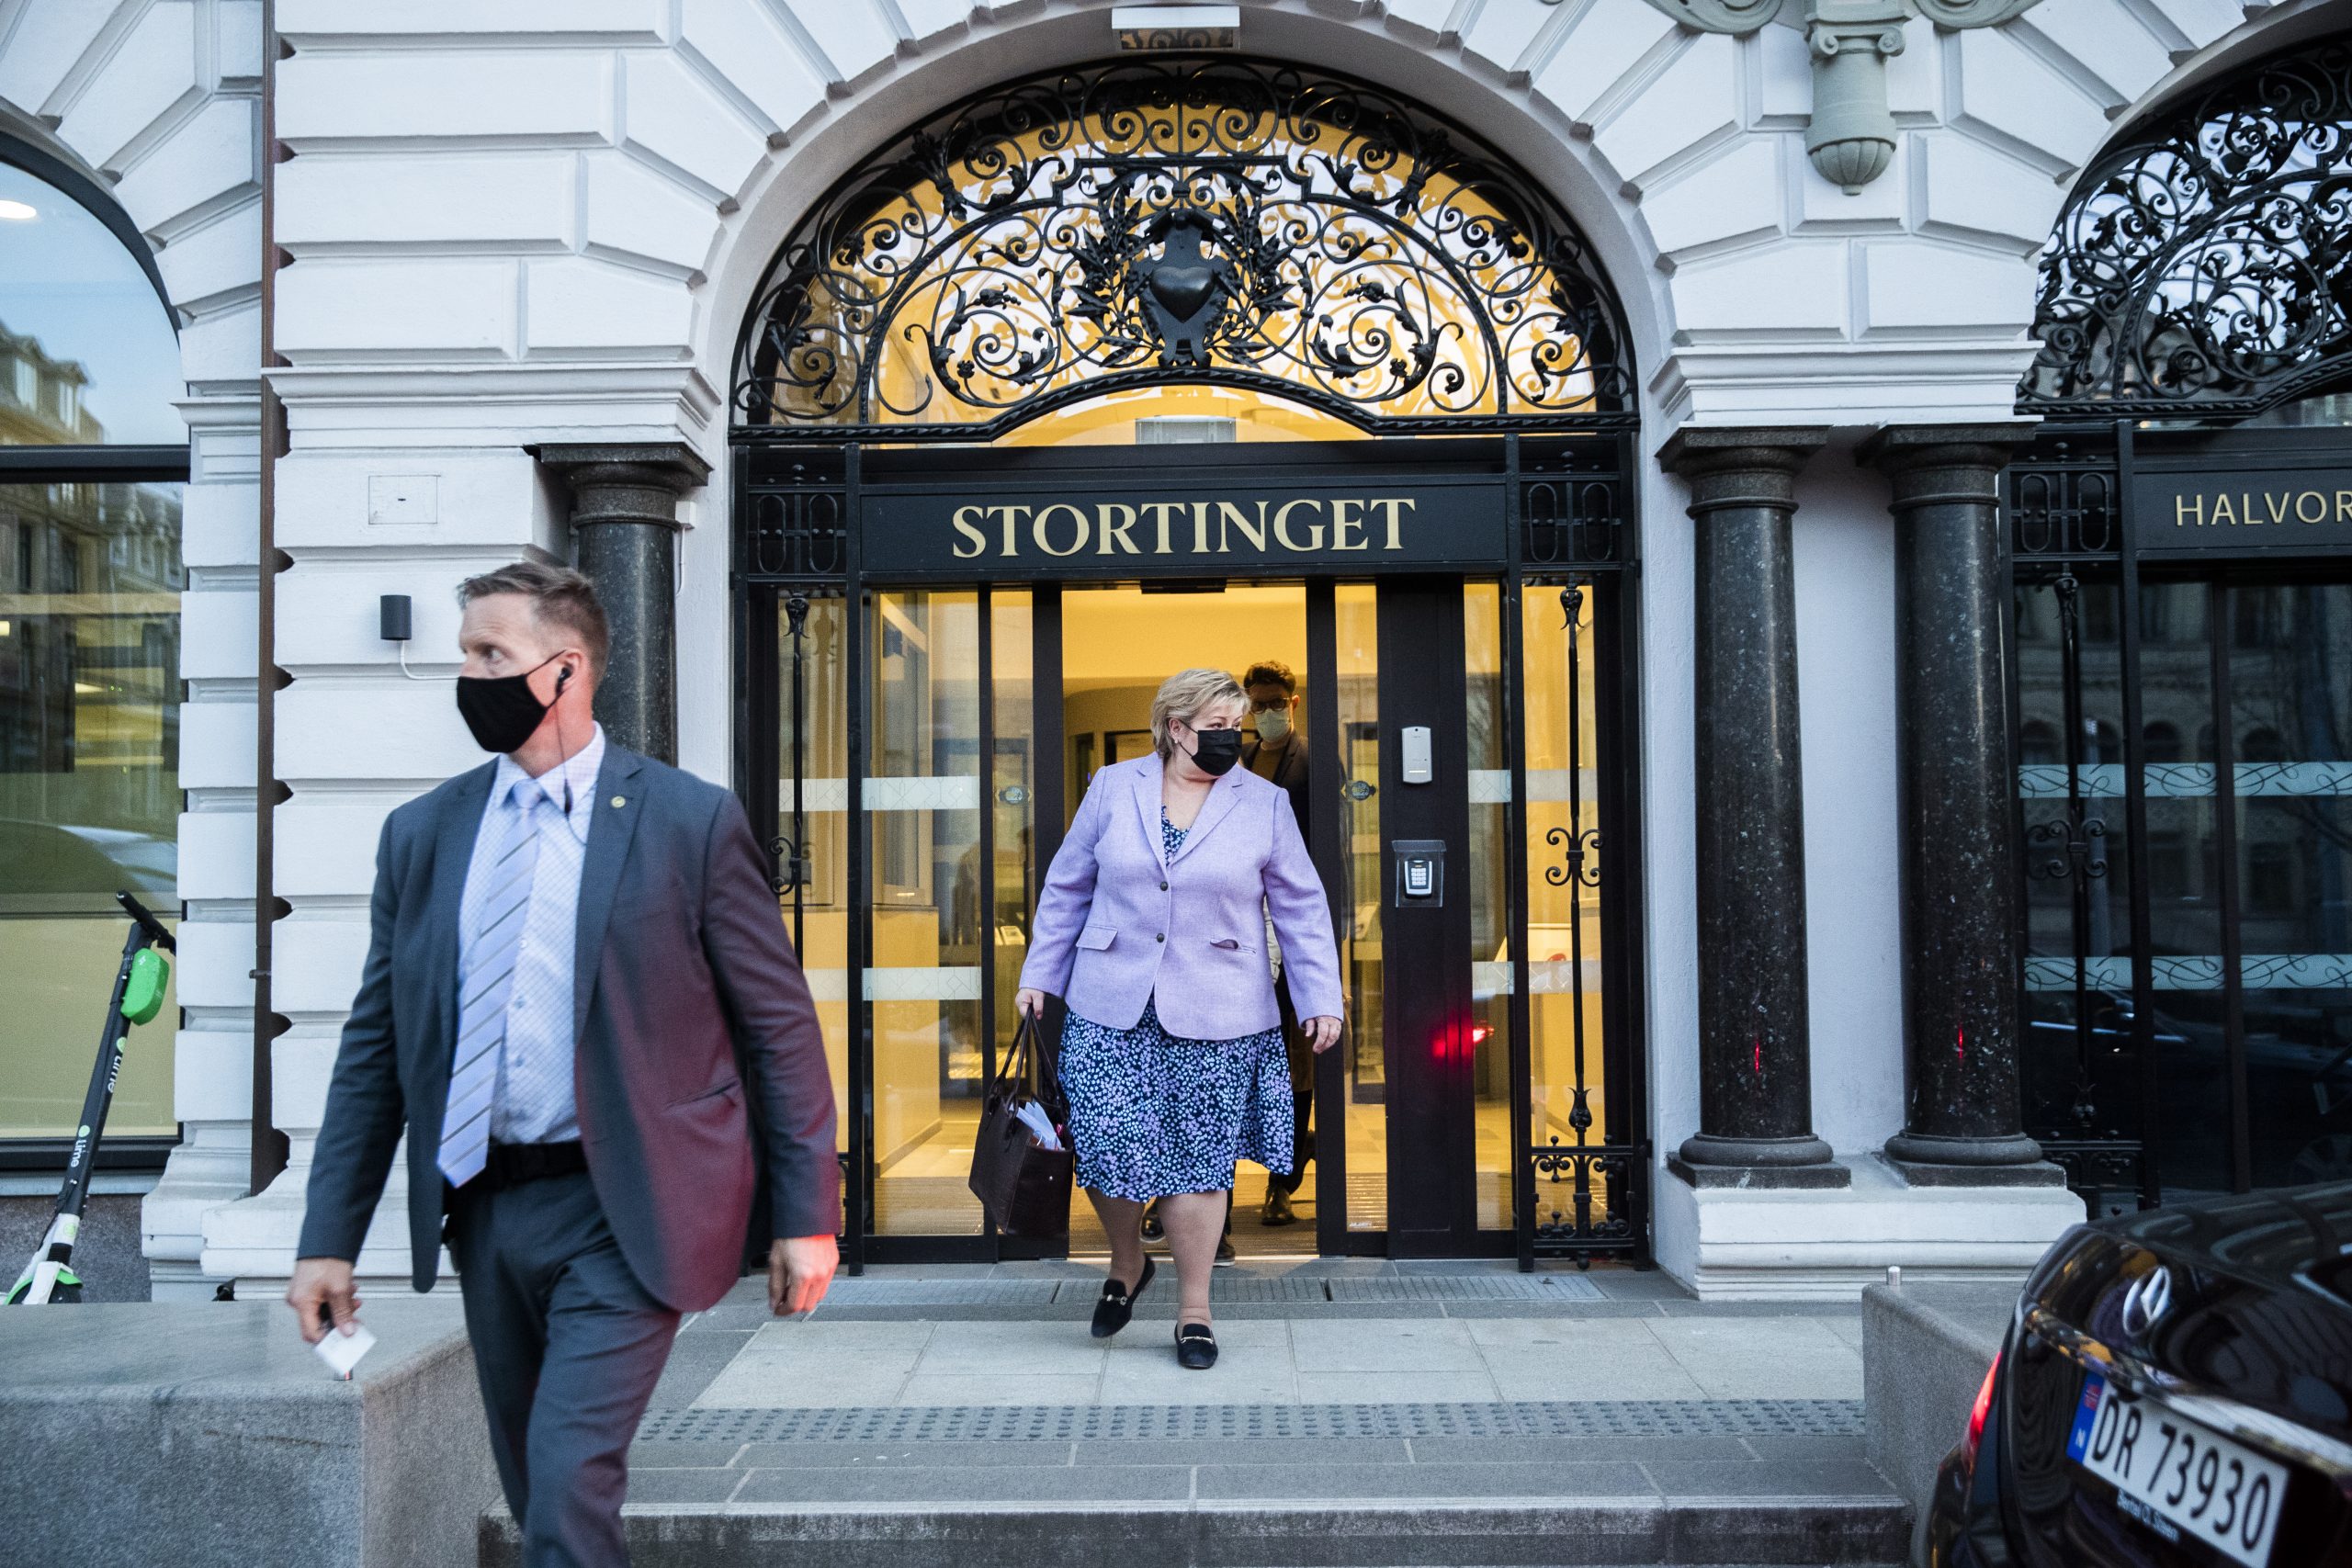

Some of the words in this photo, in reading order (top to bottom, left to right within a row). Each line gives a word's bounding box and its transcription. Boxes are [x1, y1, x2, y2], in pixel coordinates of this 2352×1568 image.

[2175, 491, 2352, 526] HALVOR
[952, 498, 1416, 558] STORTINGET
[71, 1139, 87, 1168] Lime
[2075, 1427, 2086, 1449] N
[2091, 1393, 2143, 1481] DR
[2147, 1423, 2271, 1551] 73930
